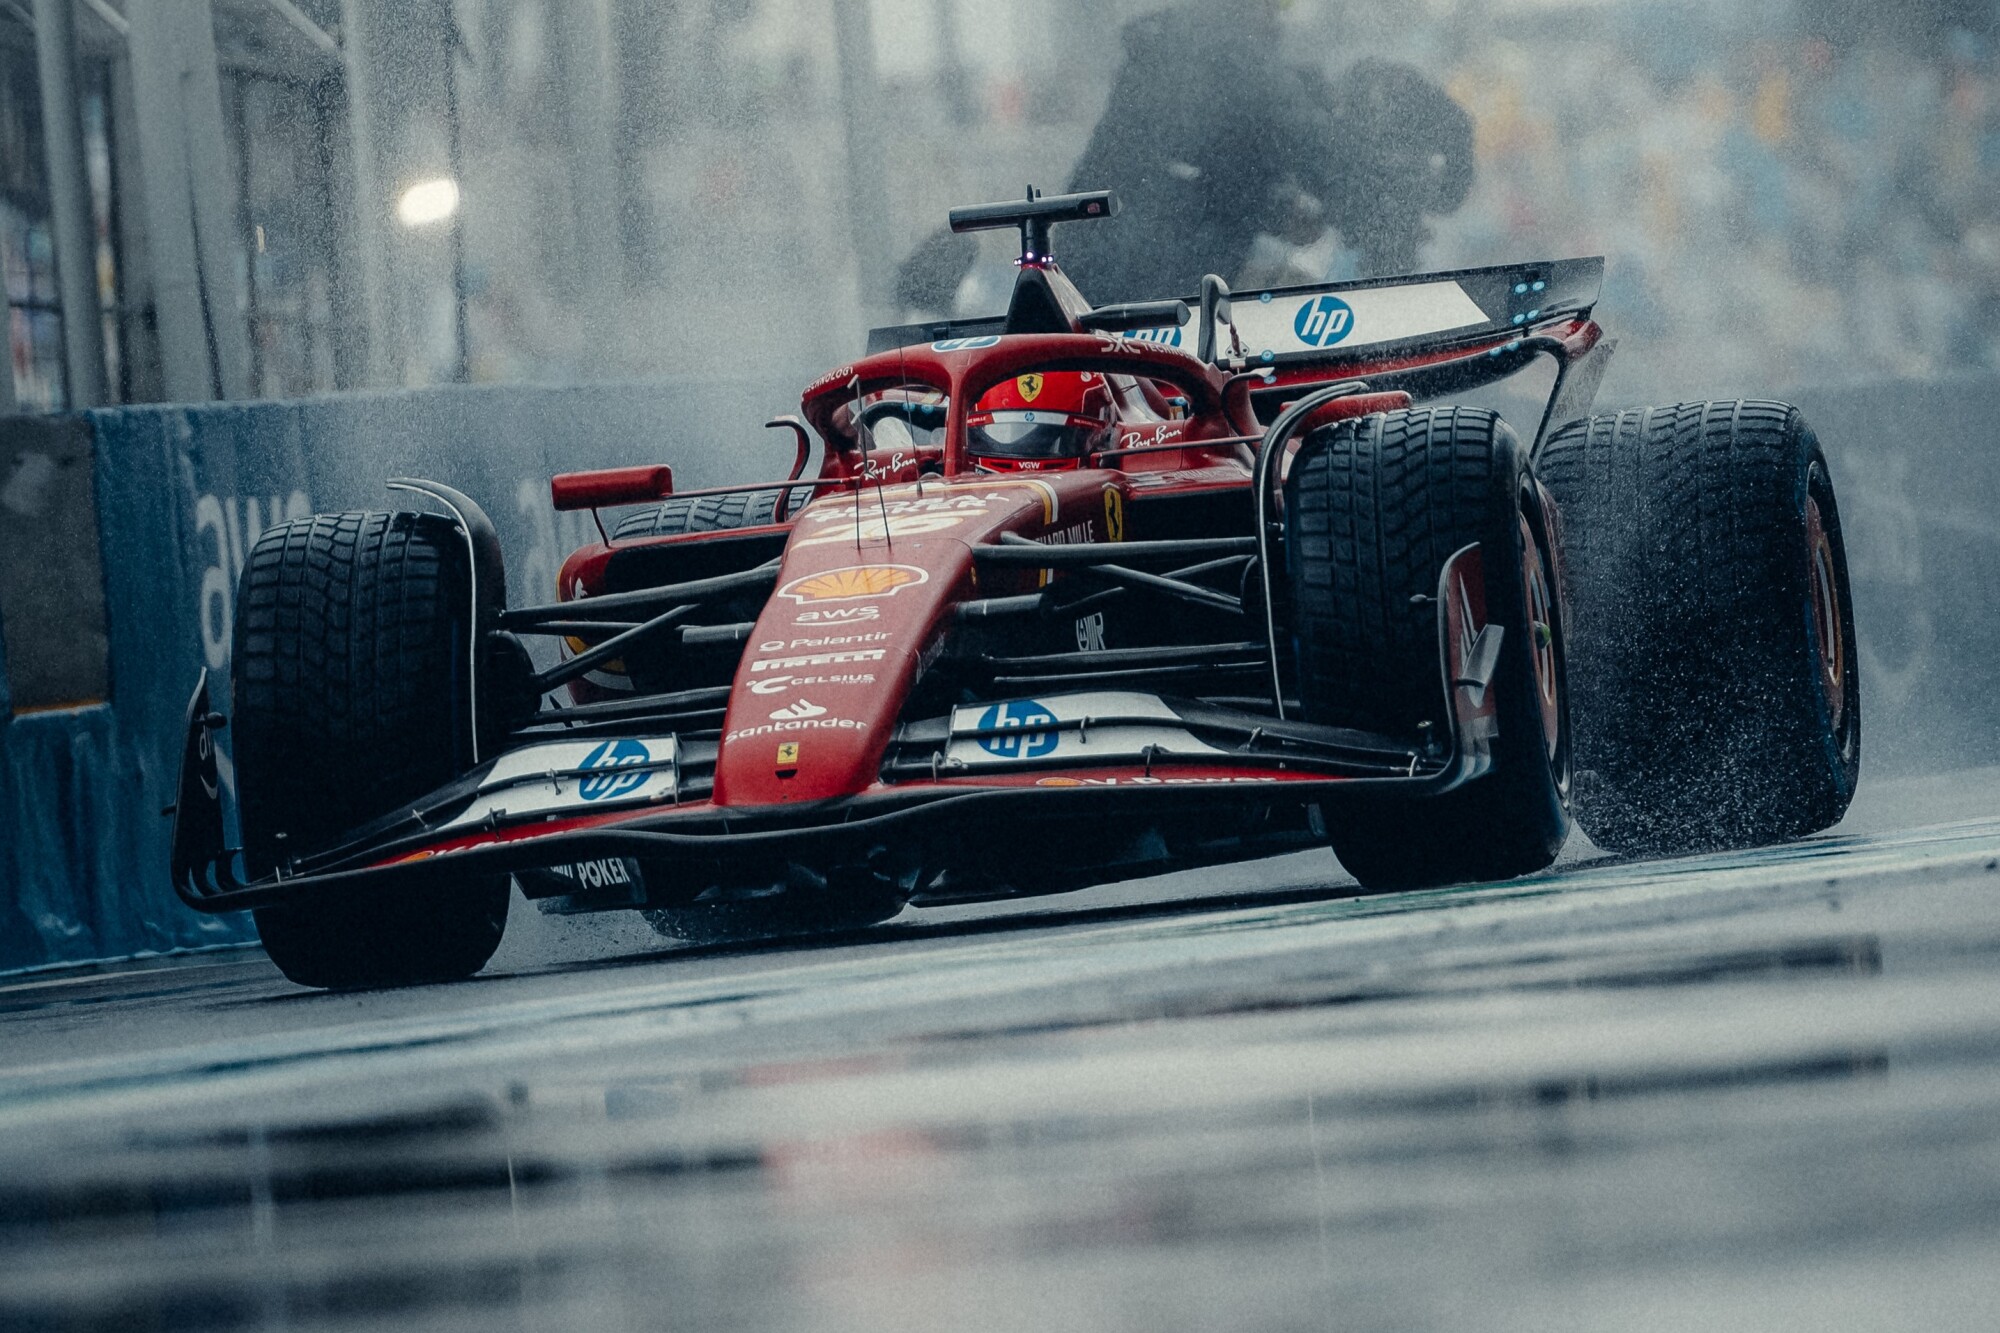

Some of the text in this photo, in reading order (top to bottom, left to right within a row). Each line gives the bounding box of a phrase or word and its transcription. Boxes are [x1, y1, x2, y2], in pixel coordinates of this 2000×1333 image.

[1301, 296, 1349, 347] hp
[1120, 425, 1182, 449] Ray-Ban
[854, 452, 917, 480] Ray-Ban
[1018, 461, 1041, 469] VGW
[796, 605, 880, 622] aws
[790, 632, 893, 649] Palantir
[750, 649, 886, 672] PIRELLI
[791, 674, 876, 686] CELSIUS
[725, 718, 868, 746] santander
[990, 703, 1051, 758] hp
[583, 740, 646, 800] hp
[576, 857, 631, 890] POKER
